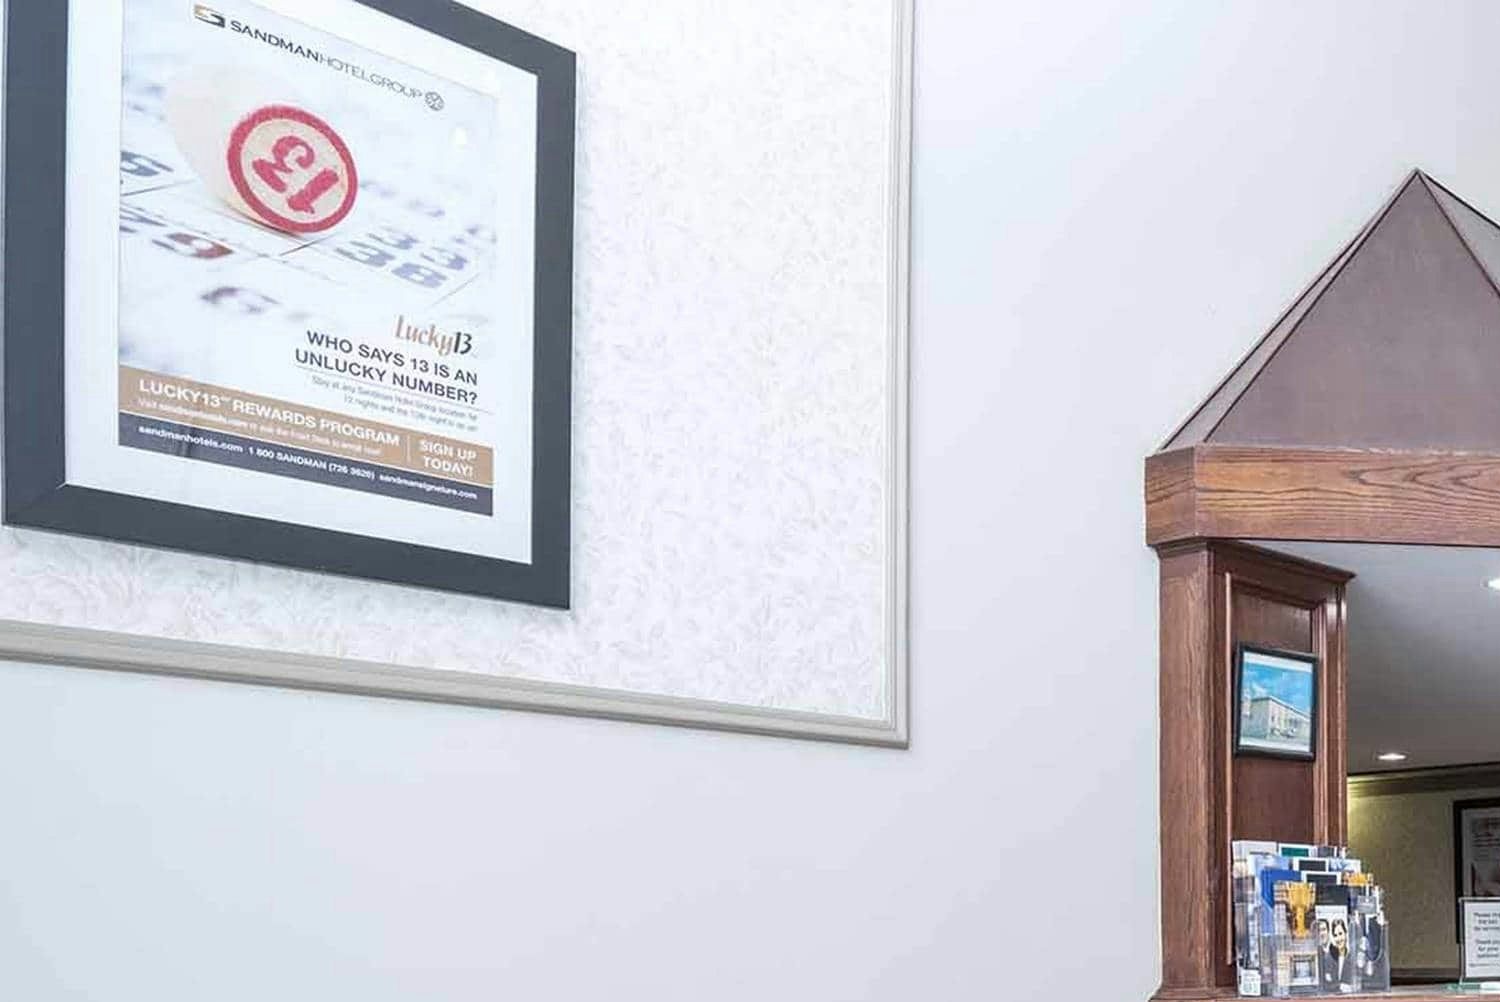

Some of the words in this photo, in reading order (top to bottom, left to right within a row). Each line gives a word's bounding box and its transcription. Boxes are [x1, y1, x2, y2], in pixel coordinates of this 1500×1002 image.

[295, 348, 386, 382] UNLUCKY
[392, 372, 478, 405] NUMBER?
[306, 330, 353, 354] WHO
[358, 343, 405, 367] SAYS
[410, 358, 429, 373] 13
[434, 363, 450, 378] IS
[454, 368, 478, 386] AN
[233, 399, 316, 428] REWARDS
[320, 419, 400, 446] PROGRAM
[138, 425, 244, 453] sandmanhotels.com
[276, 452, 326, 470] SANDMAN
[420, 440, 453, 457] SIGN
[457, 449, 477, 461] UP
[423, 455, 474, 477] TODAY!
